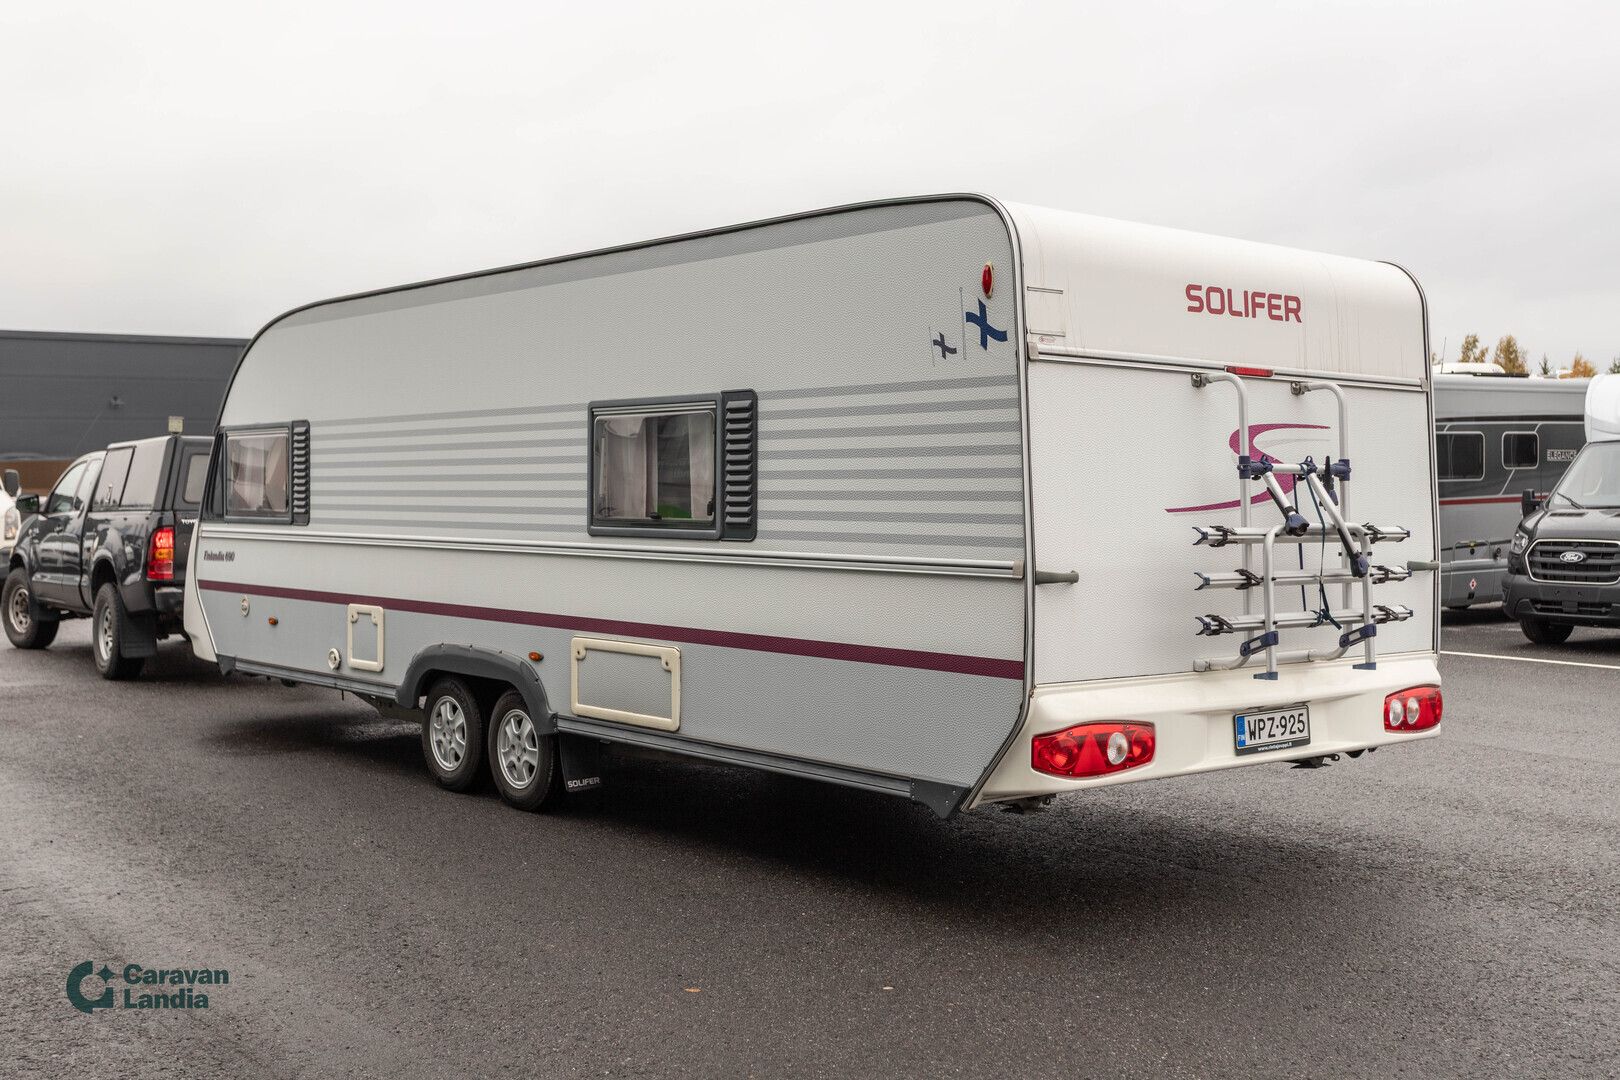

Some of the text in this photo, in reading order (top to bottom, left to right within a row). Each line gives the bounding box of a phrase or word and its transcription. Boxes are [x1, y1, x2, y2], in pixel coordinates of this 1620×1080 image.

[1185, 284, 1302, 323] SOLIFER
[1247, 713, 1305, 741] WPZ-925
[567, 777, 600, 788] SOLIFER
